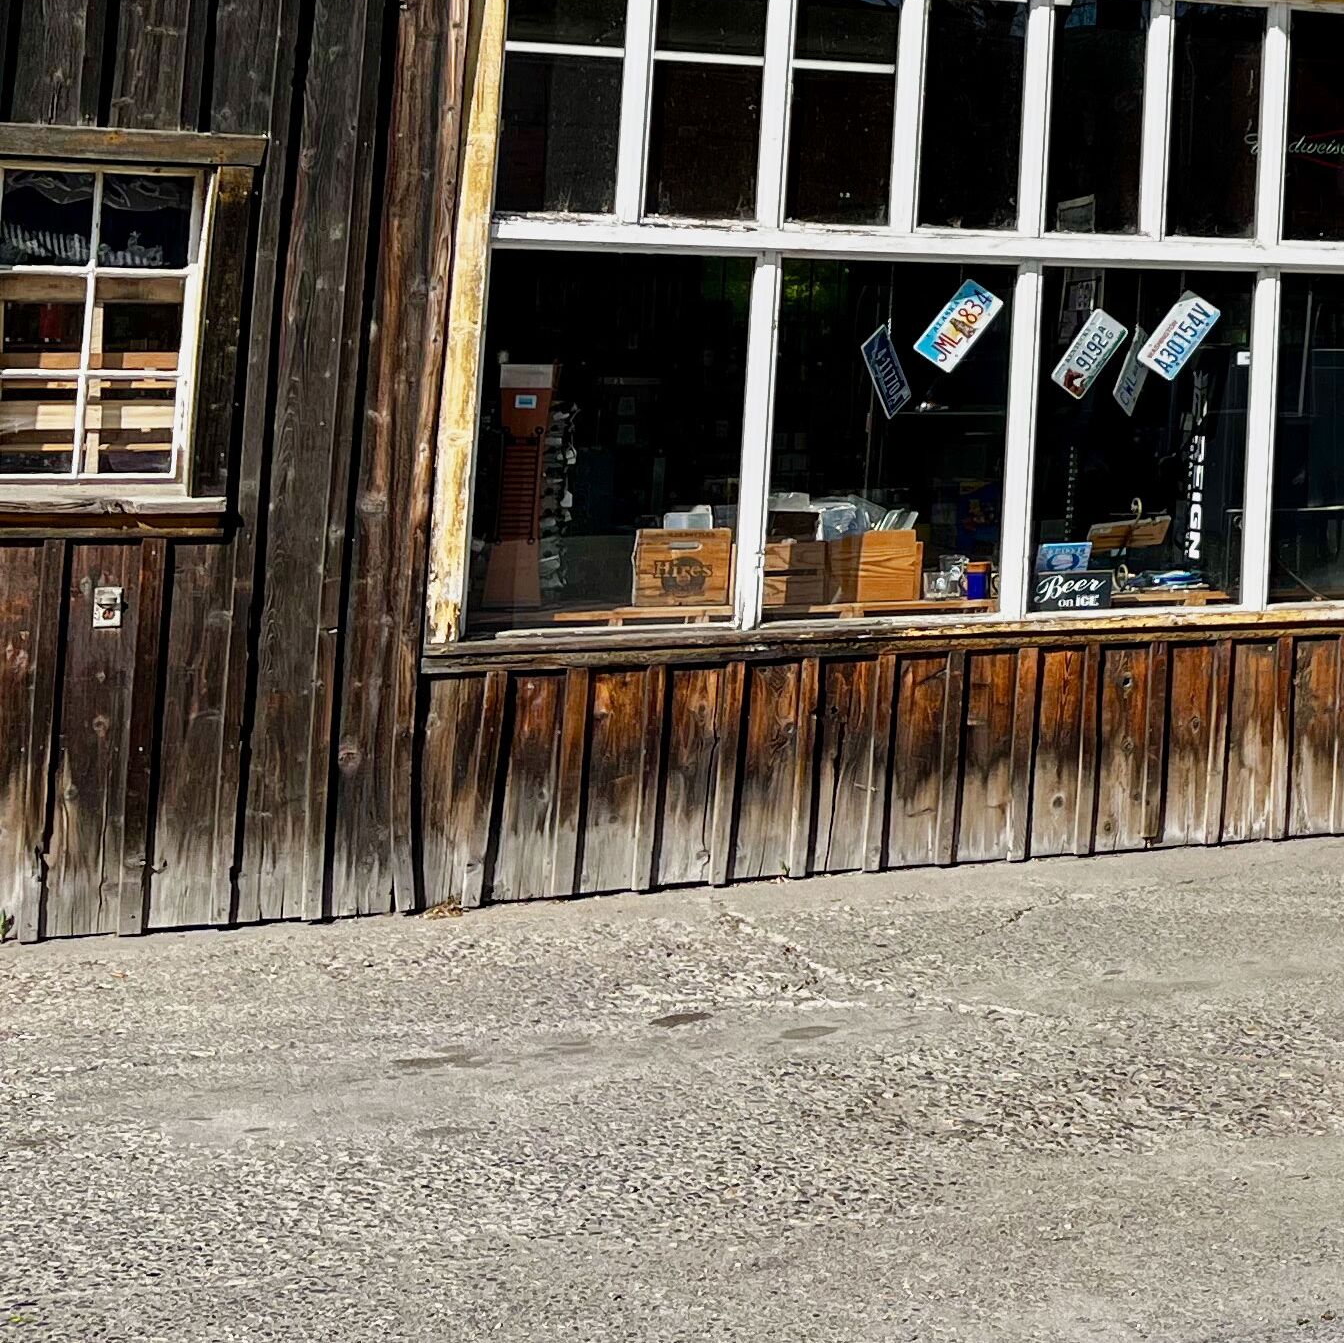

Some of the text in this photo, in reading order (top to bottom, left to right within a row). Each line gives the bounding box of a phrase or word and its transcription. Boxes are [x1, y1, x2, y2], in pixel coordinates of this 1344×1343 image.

[930, 289, 992, 363] JML 834
[1153, 303, 1208, 374] A30154V
[1077, 334, 1106, 371] 9192
[654, 560, 714, 579] Hires
[1034, 575, 1106, 603] Beer
[1058, 597, 1074, 608] on
